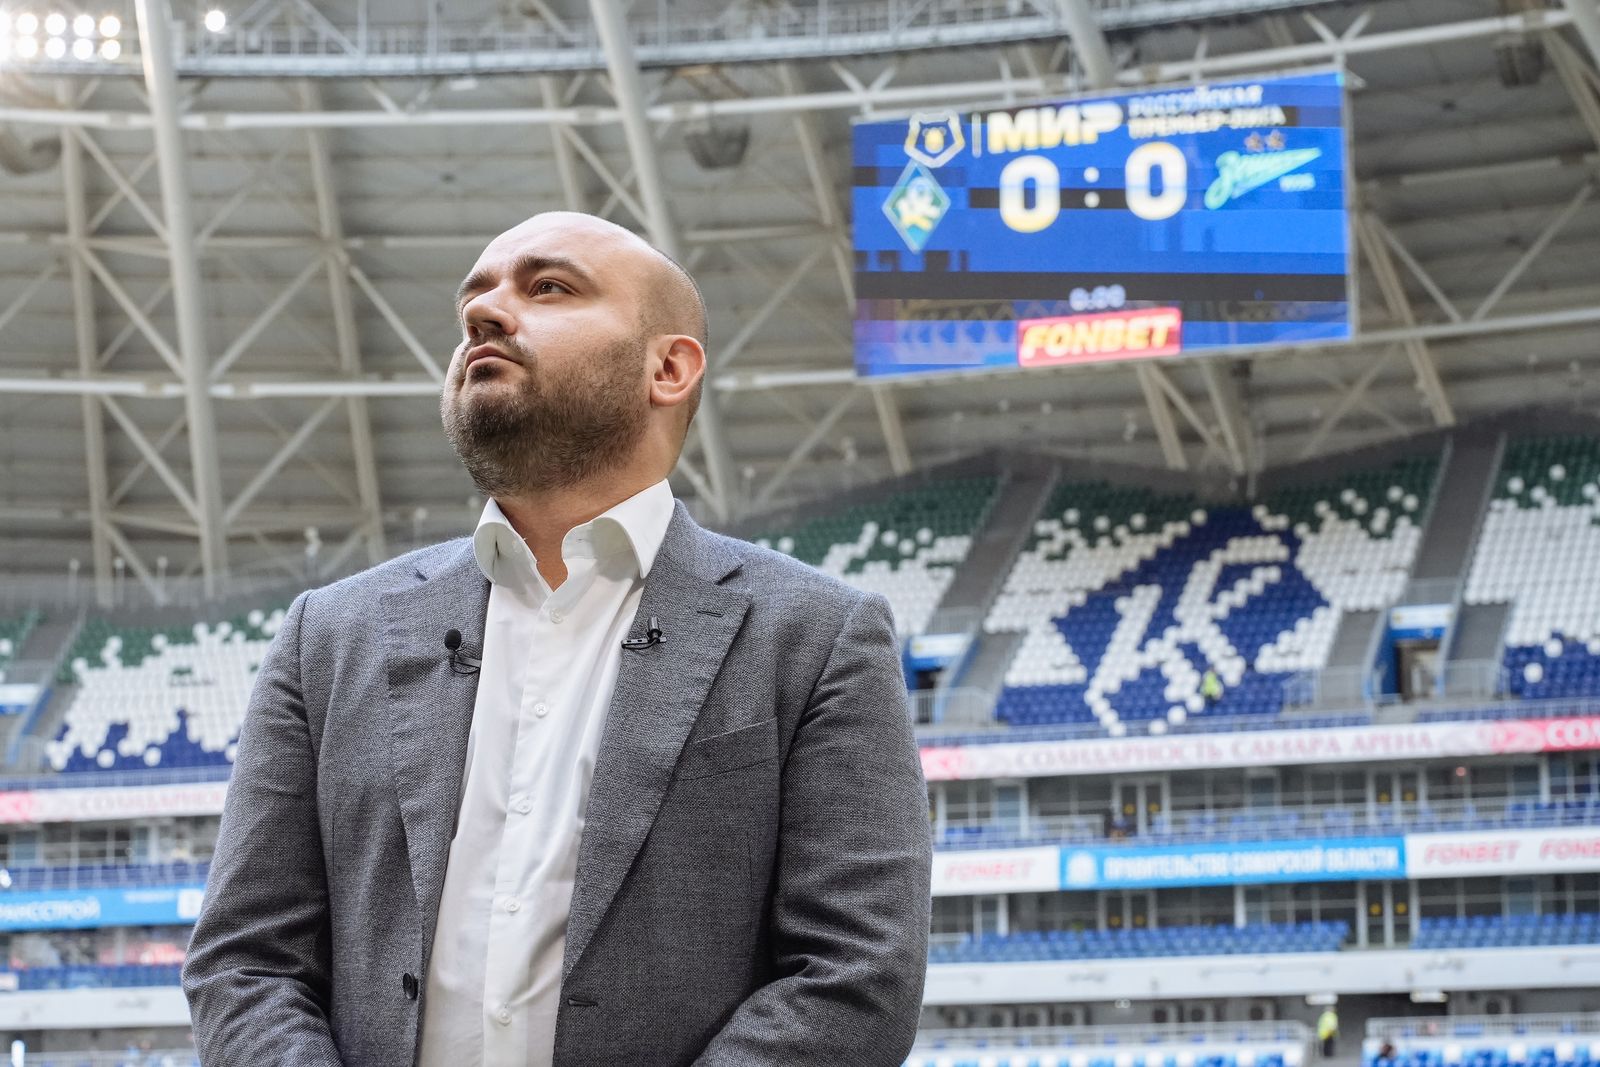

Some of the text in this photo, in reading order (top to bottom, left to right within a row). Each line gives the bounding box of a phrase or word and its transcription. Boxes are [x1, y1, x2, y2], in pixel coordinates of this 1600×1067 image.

[987, 101, 1123, 154] МИР
[999, 155, 1061, 233] 0
[1125, 141, 1187, 221] 0
[1020, 314, 1178, 359] FONBET
[944, 857, 1035, 882] FONBET
[1424, 840, 1520, 865] FONBET
